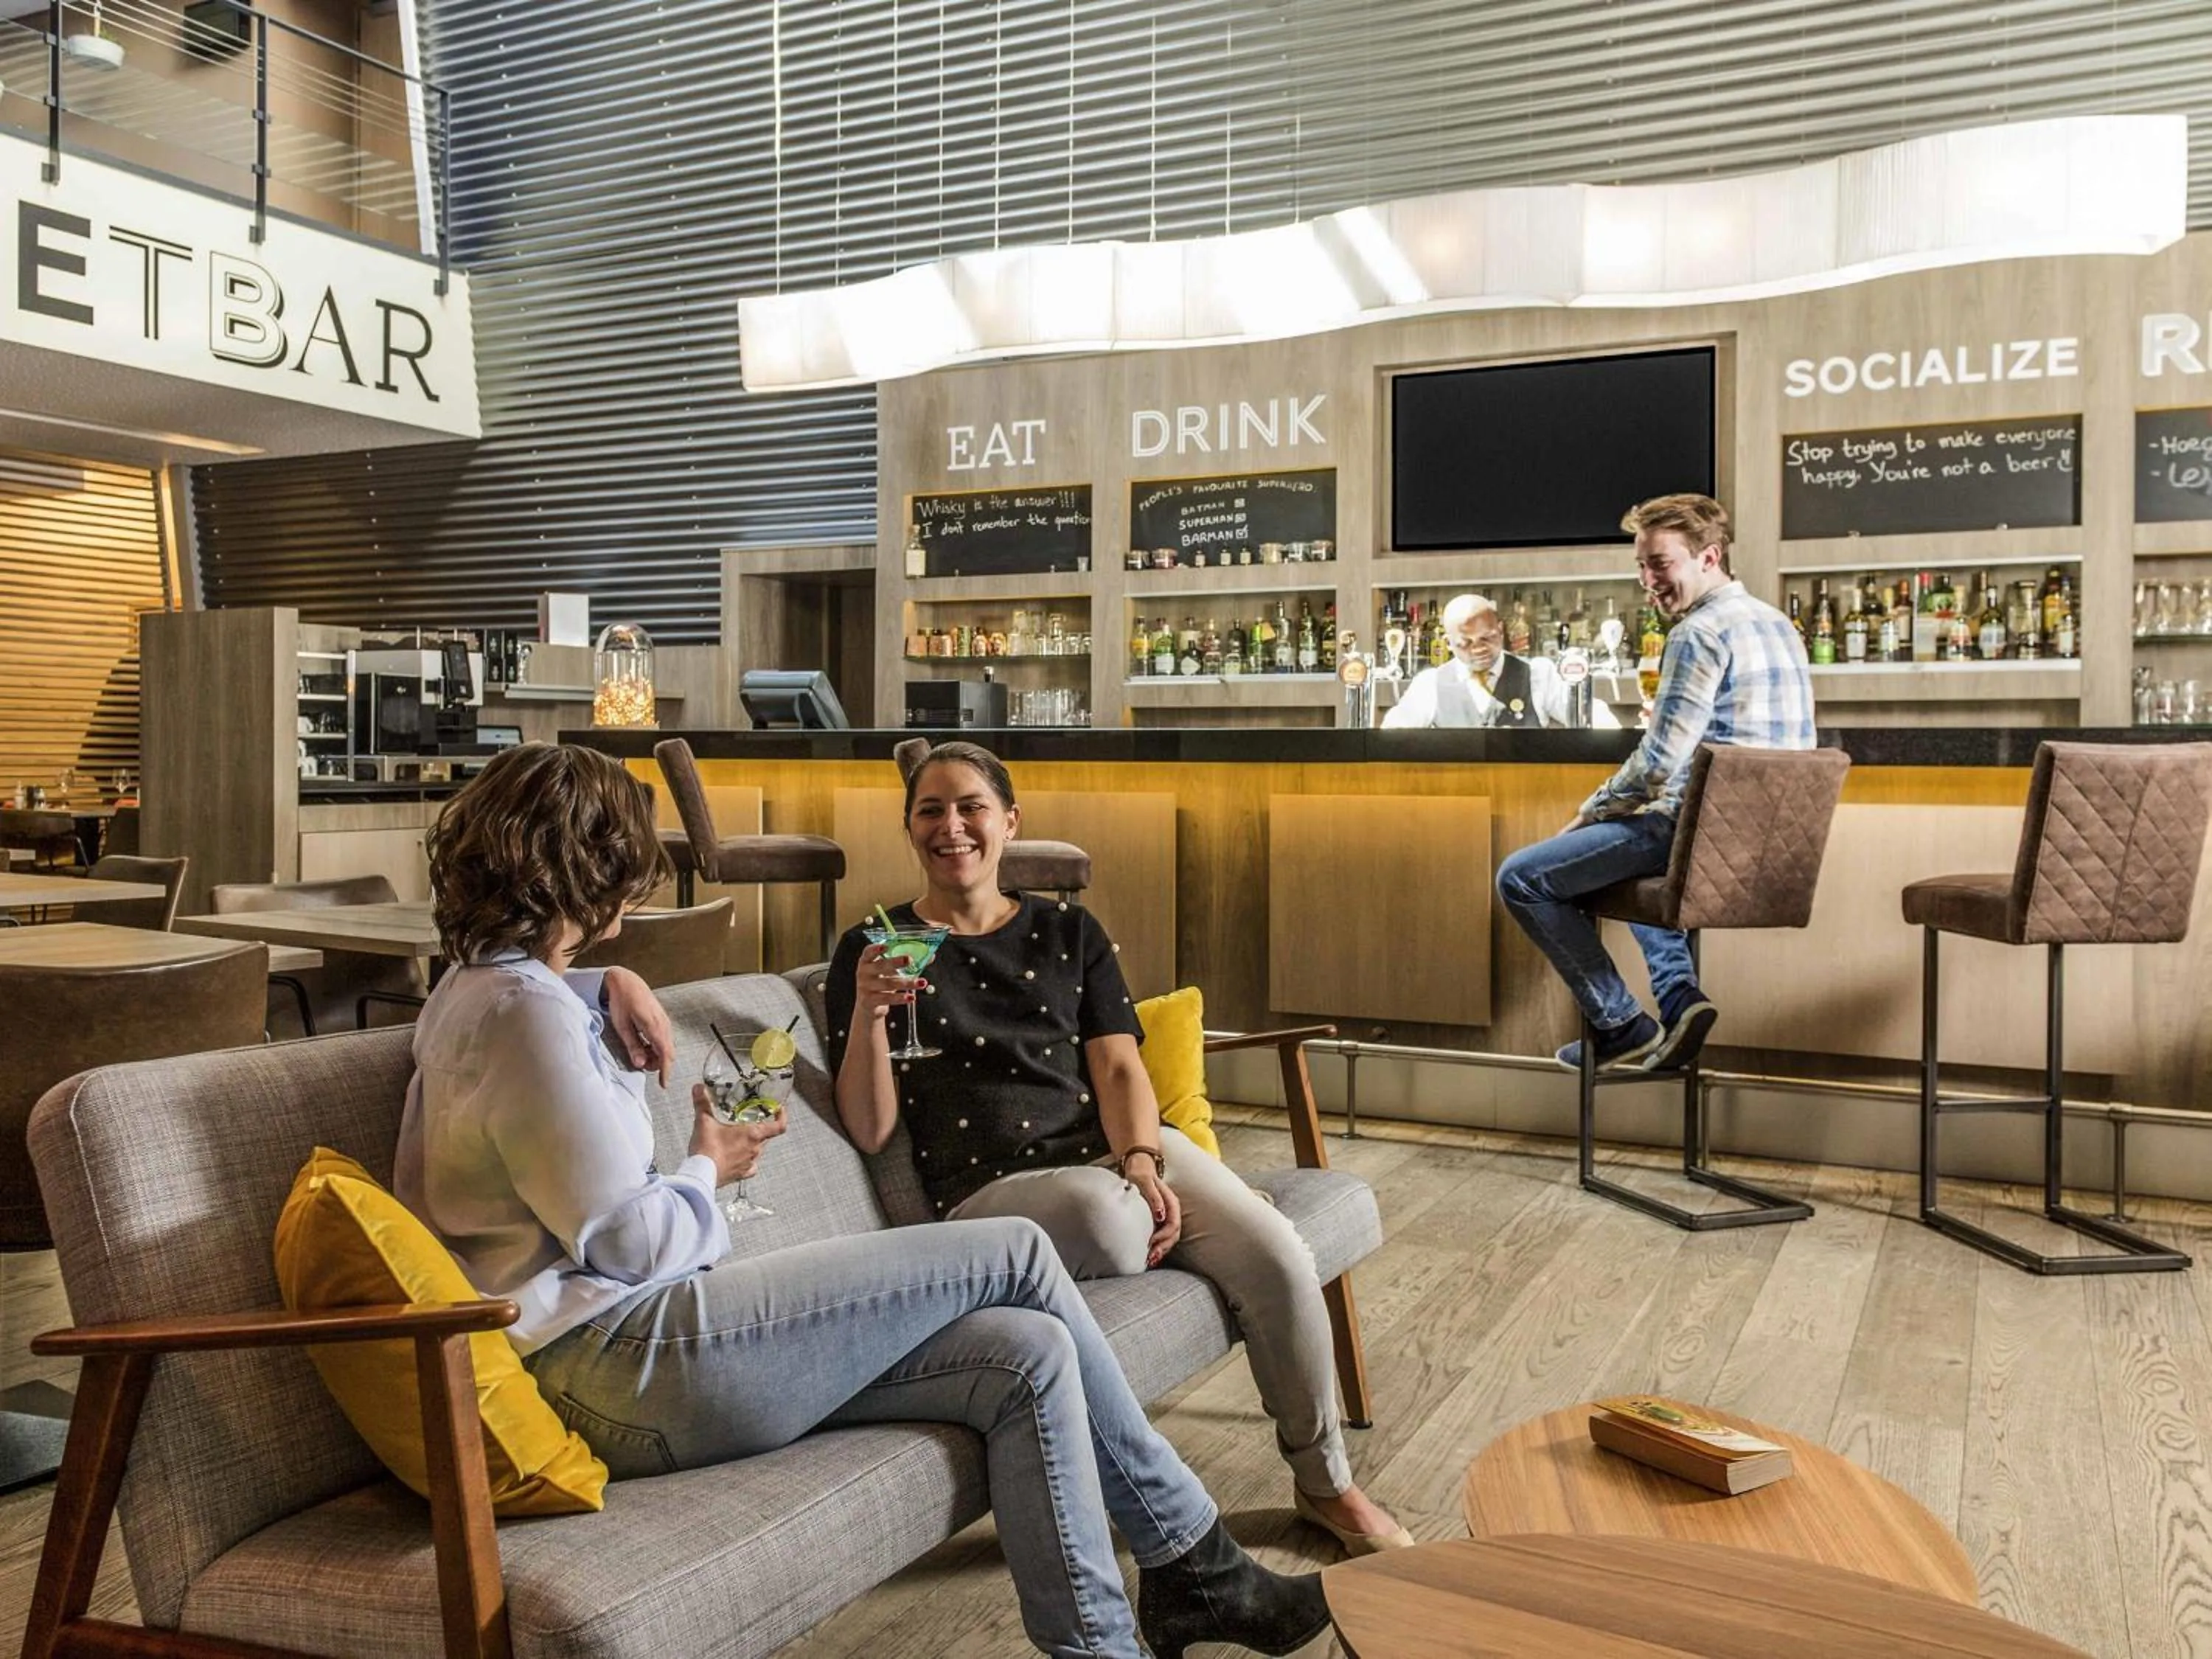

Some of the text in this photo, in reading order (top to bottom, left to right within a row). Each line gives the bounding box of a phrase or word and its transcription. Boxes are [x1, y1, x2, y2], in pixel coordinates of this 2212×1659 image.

[2141, 310, 2212, 377] R
[1784, 337, 2079, 398] SOCIALIZE
[1132, 394, 1326, 458] DRINK
[947, 420, 1046, 470] EAT
[1786, 428, 2076, 466] Stop trying to make everyone
[1870, 459, 1931, 482] You're
[1942, 458, 1974, 477] not
[1979, 461, 1996, 474] a
[1193, 480, 1248, 493] FAVOURITE
[915, 499, 966, 520] Whisky
[974, 498, 983, 512] is
[989, 495, 1009, 509] the
[1180, 501, 1225, 515] BATMAN
[922, 521, 932, 539] I
[972, 515, 1020, 532] remember
[1026, 512, 1048, 526] the
[1178, 513, 1233, 530] SUPERMAN
[1181, 530, 1233, 546] BARMAN
